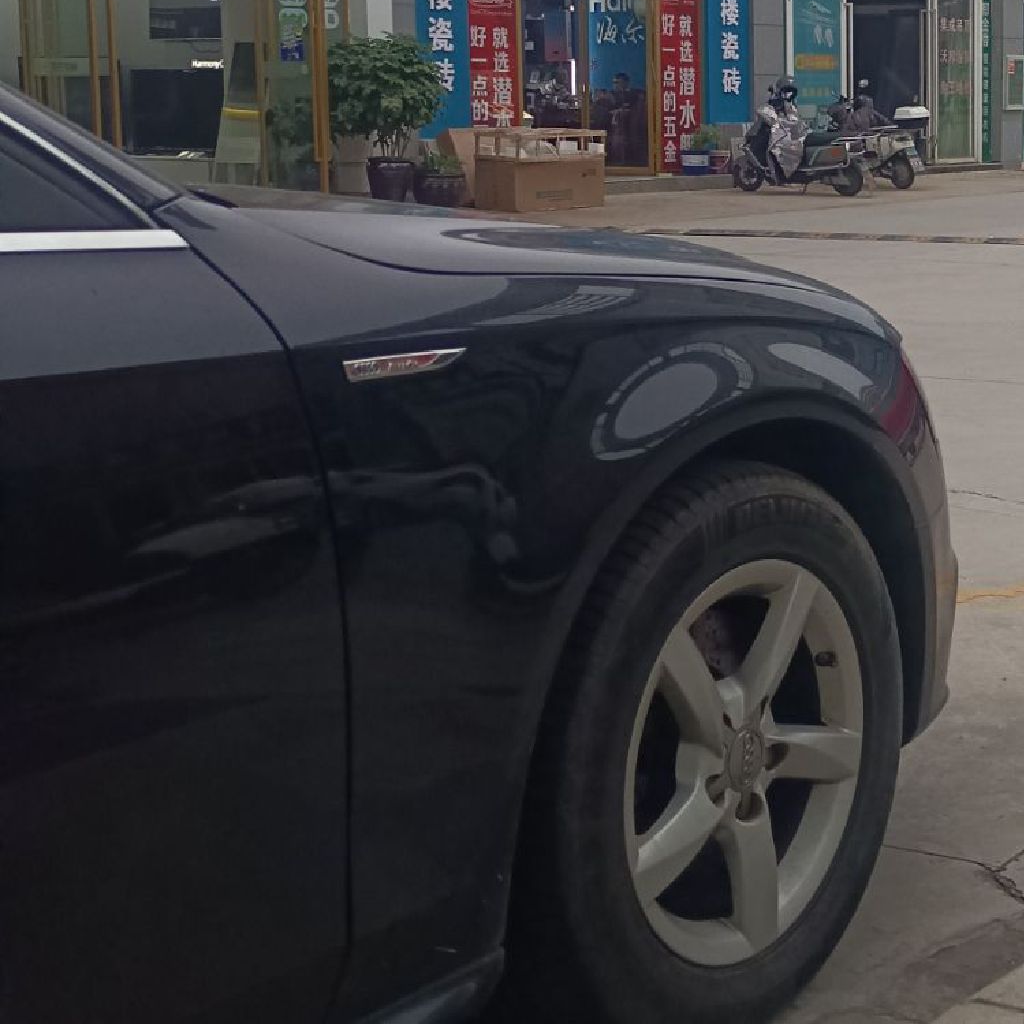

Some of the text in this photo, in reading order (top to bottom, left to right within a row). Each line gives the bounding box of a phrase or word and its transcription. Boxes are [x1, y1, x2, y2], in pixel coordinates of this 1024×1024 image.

[470, 25, 489, 127] 好一点的
[661, 14, 677, 163] 好一点的五金
